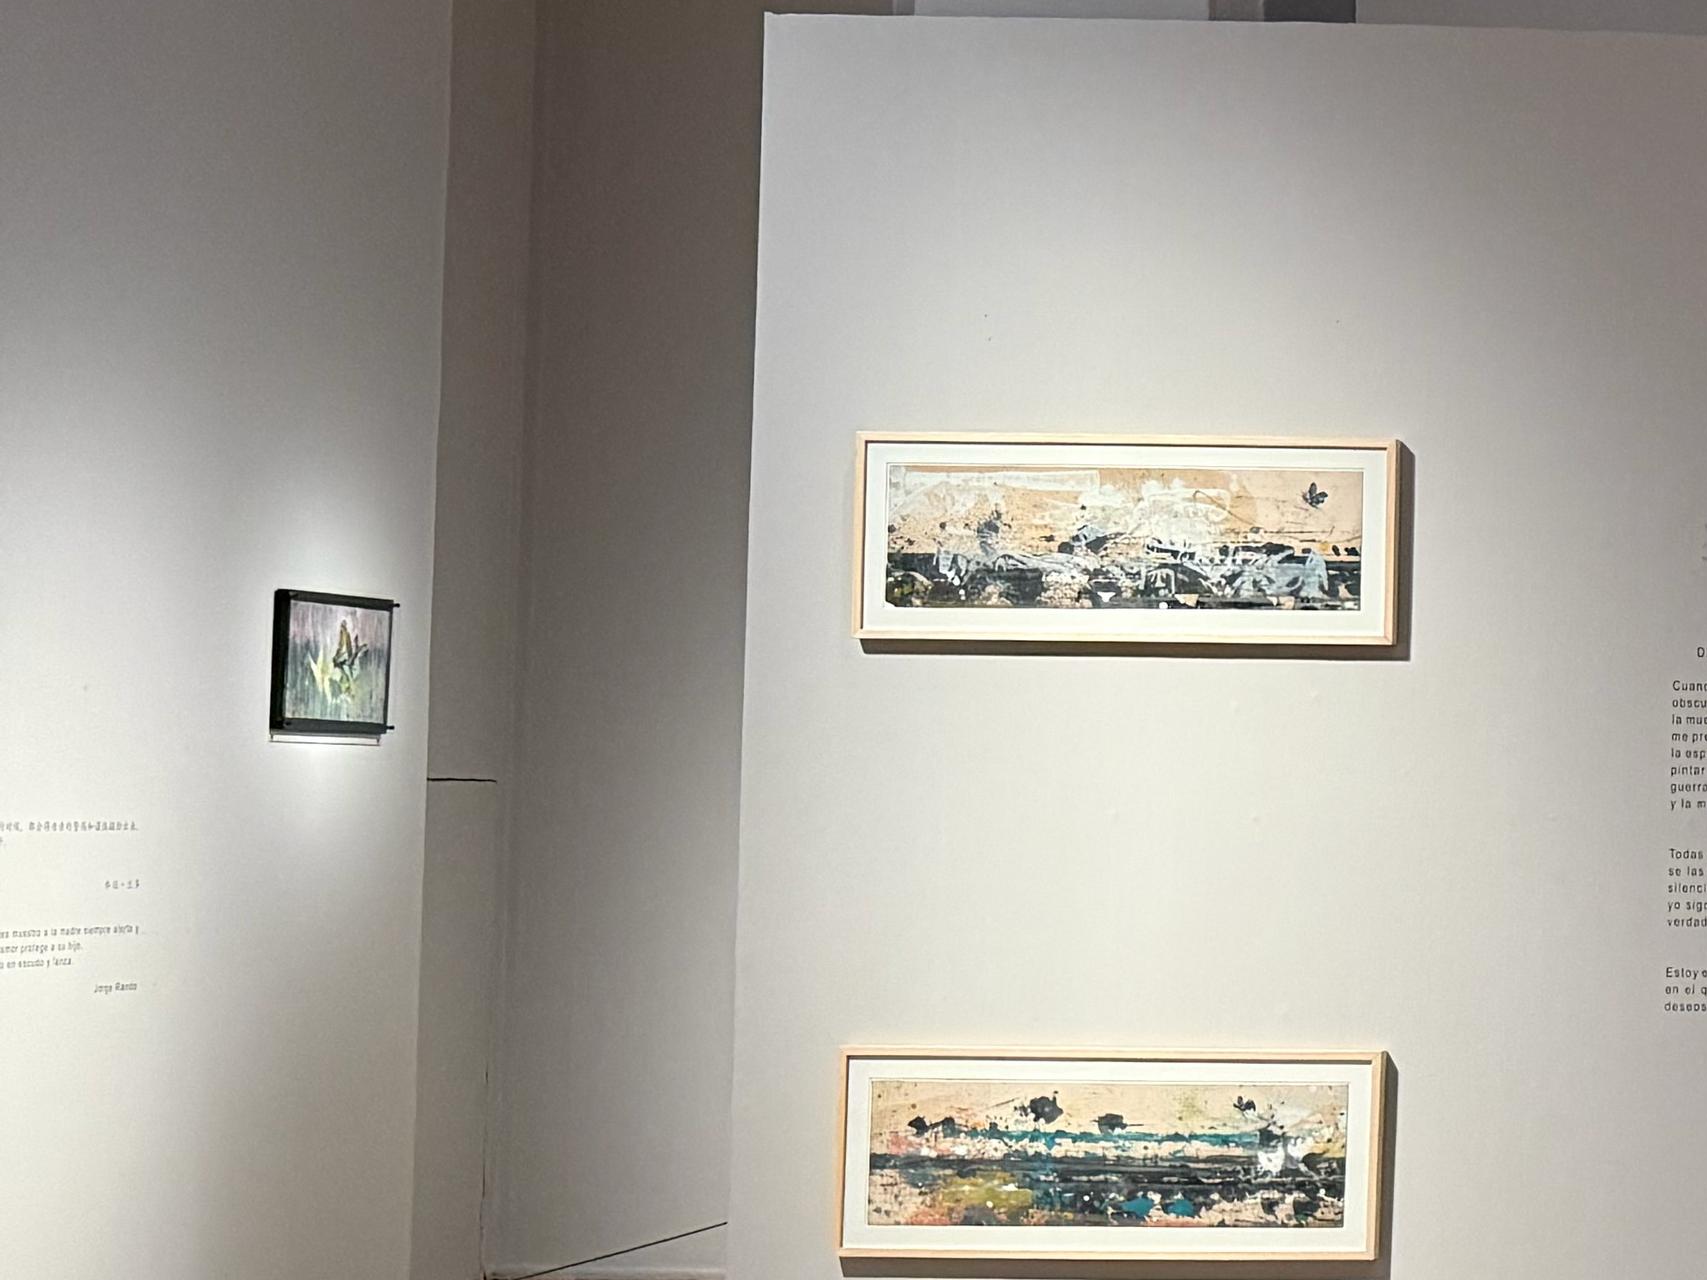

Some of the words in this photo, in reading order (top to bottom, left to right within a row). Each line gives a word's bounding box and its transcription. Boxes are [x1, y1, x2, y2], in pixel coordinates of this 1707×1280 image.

[1670, 765, 1706, 778] pintar
[1668, 847, 1704, 860] Todas
[1686, 865, 1704, 877] las
[1665, 966, 1700, 980] Estoy
[1663, 1000, 1707, 1012] deseos
